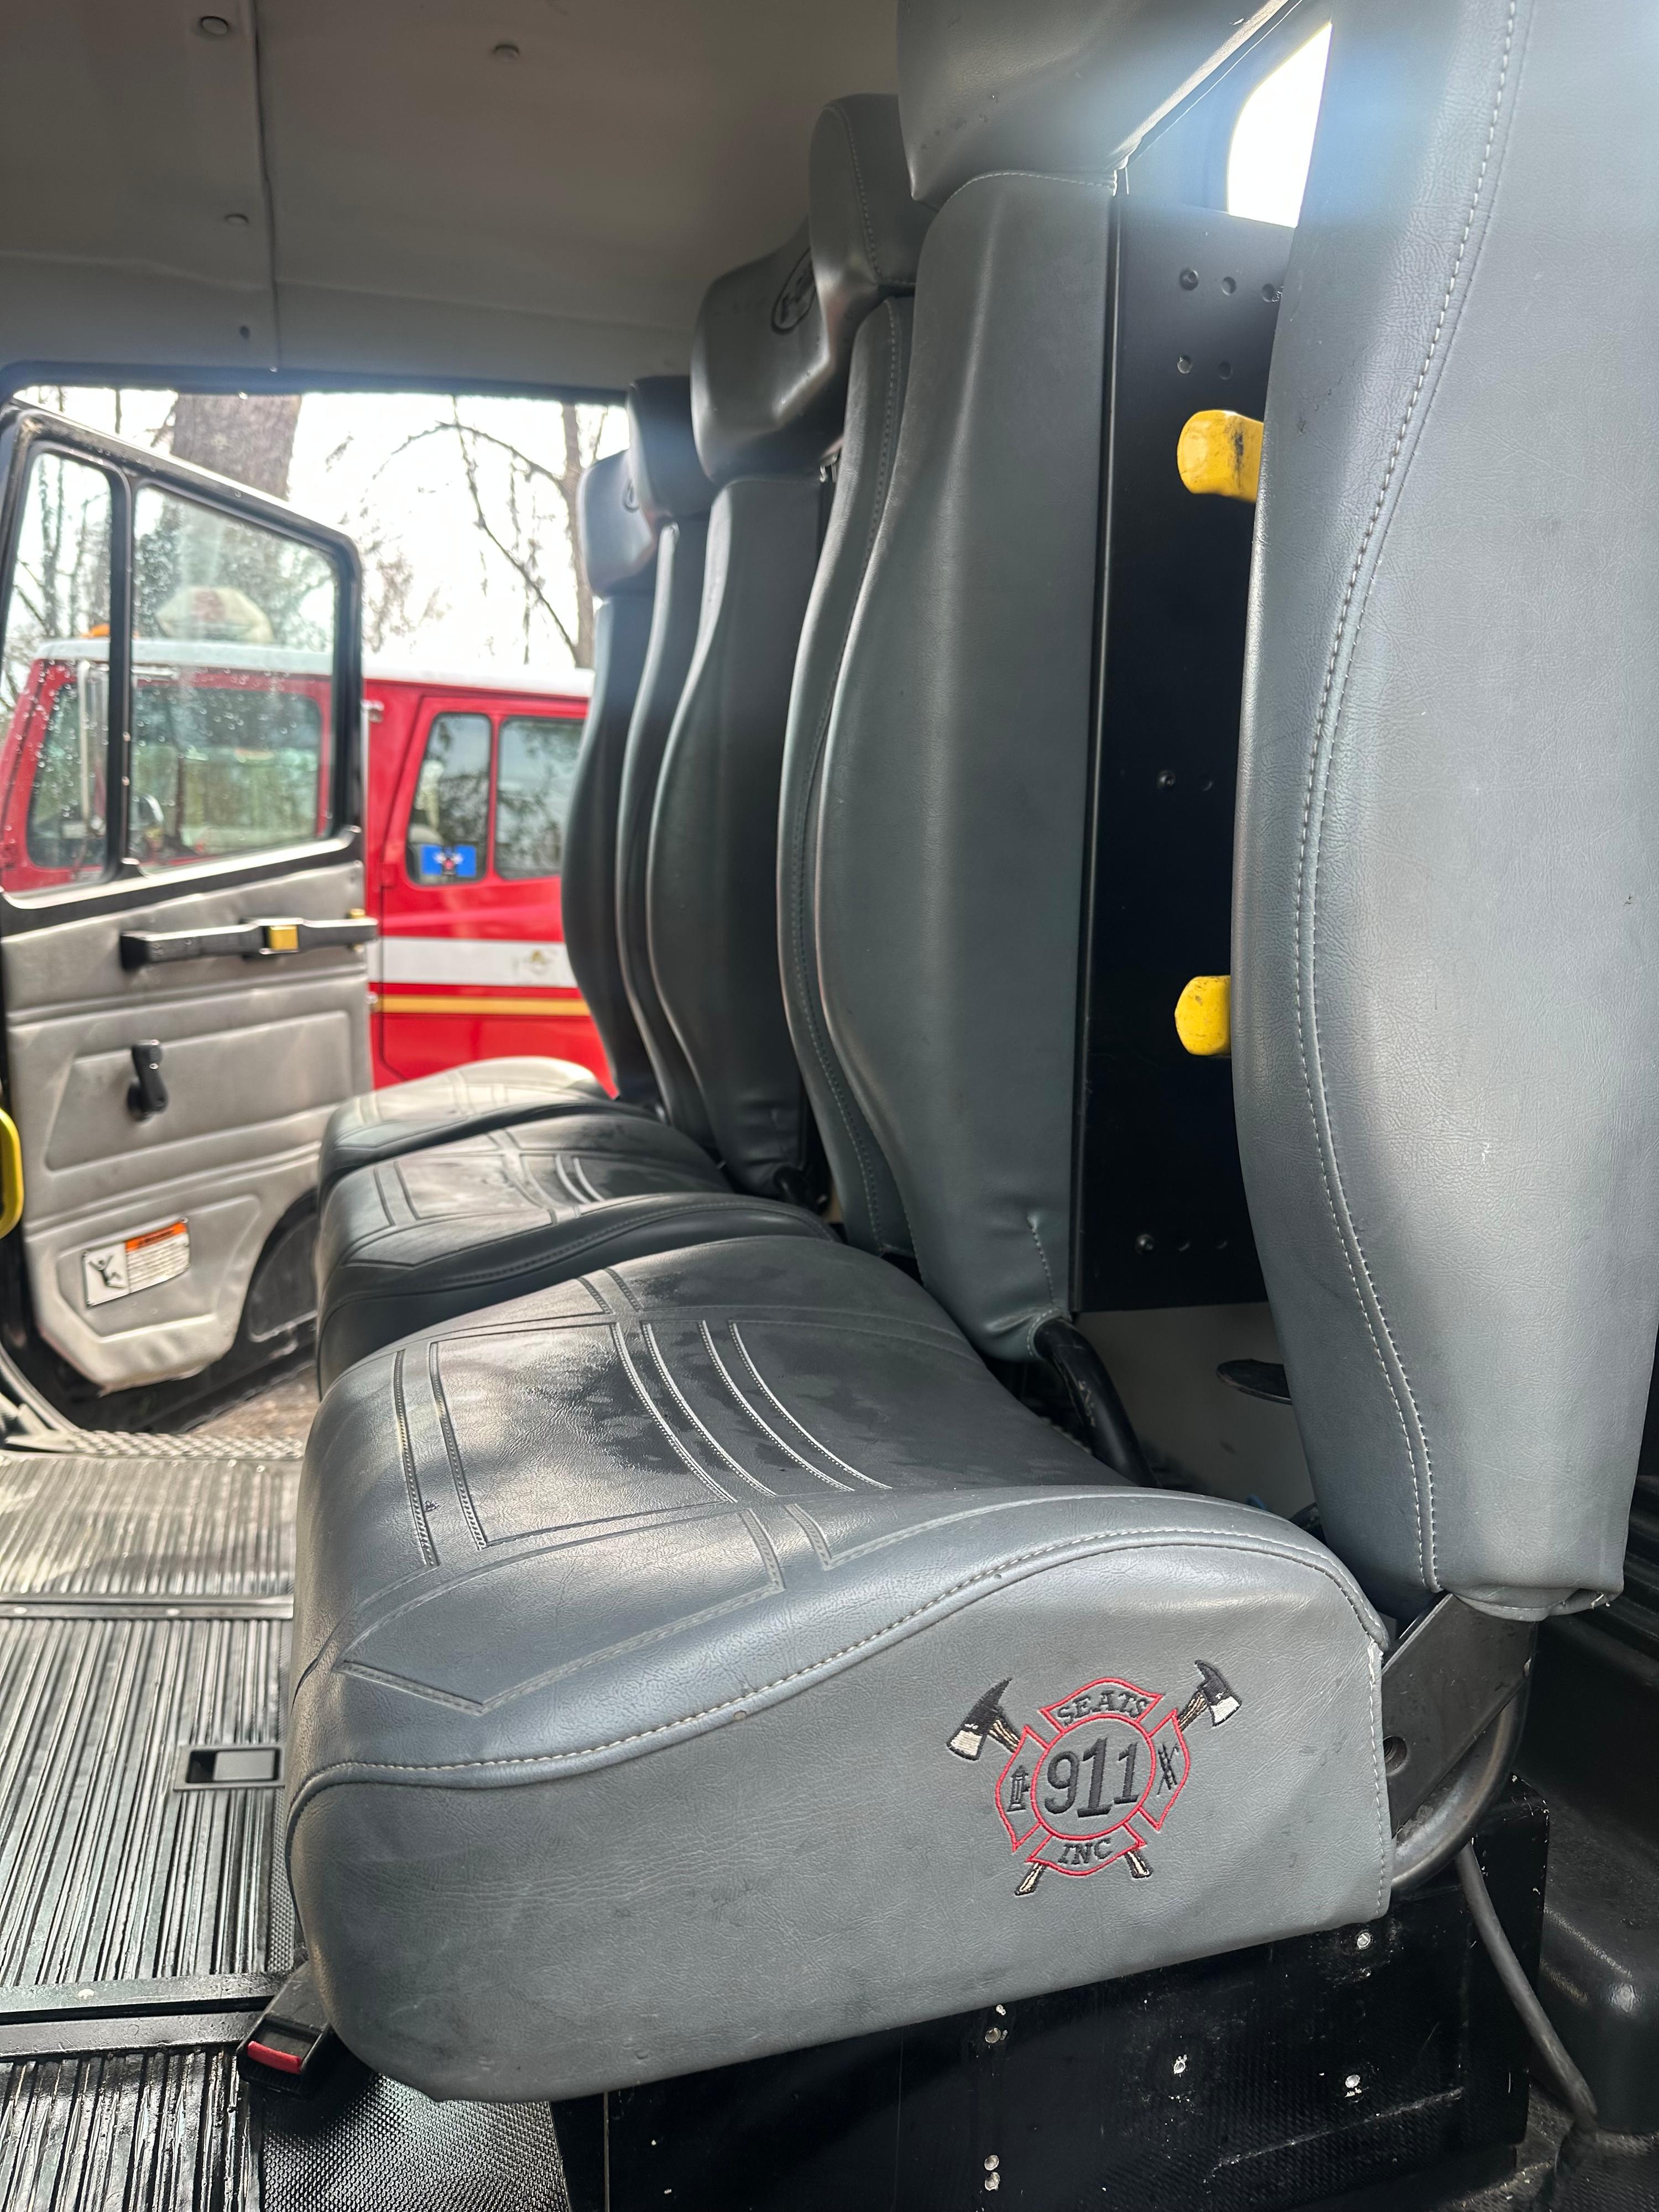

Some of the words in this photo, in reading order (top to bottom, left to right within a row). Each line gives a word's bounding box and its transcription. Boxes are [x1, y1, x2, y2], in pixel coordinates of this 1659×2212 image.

[1057, 1690, 1150, 1726] SEATS
[1044, 1737, 1139, 1818] 911
[1058, 1839, 1112, 1865] INC
